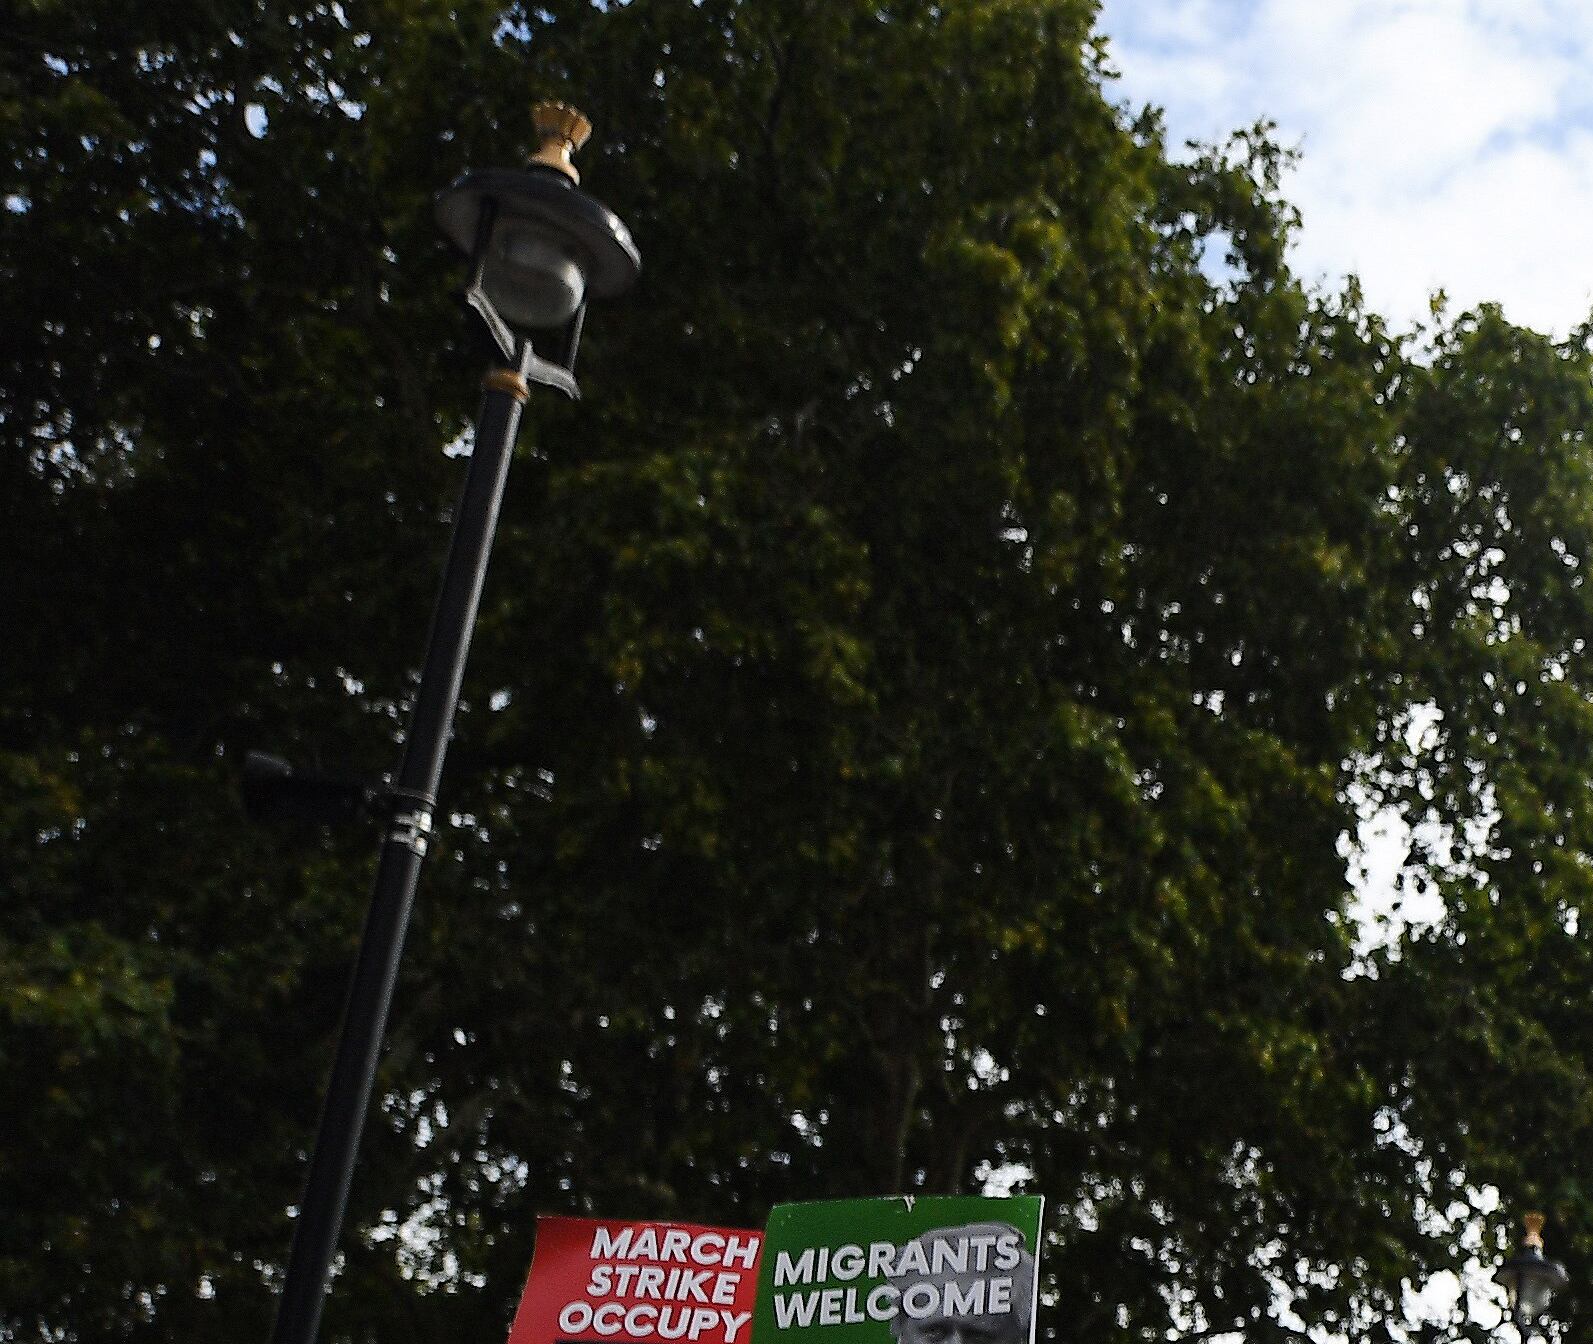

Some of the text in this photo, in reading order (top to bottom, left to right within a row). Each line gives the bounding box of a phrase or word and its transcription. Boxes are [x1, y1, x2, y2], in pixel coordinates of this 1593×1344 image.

[591, 1227, 759, 1269] MARCH
[774, 1235, 1021, 1287] MIGRANTS
[587, 1266, 740, 1305] STRIKE
[772, 1277, 1013, 1330] WELCOME
[559, 1303, 752, 1344] OCCUPY
